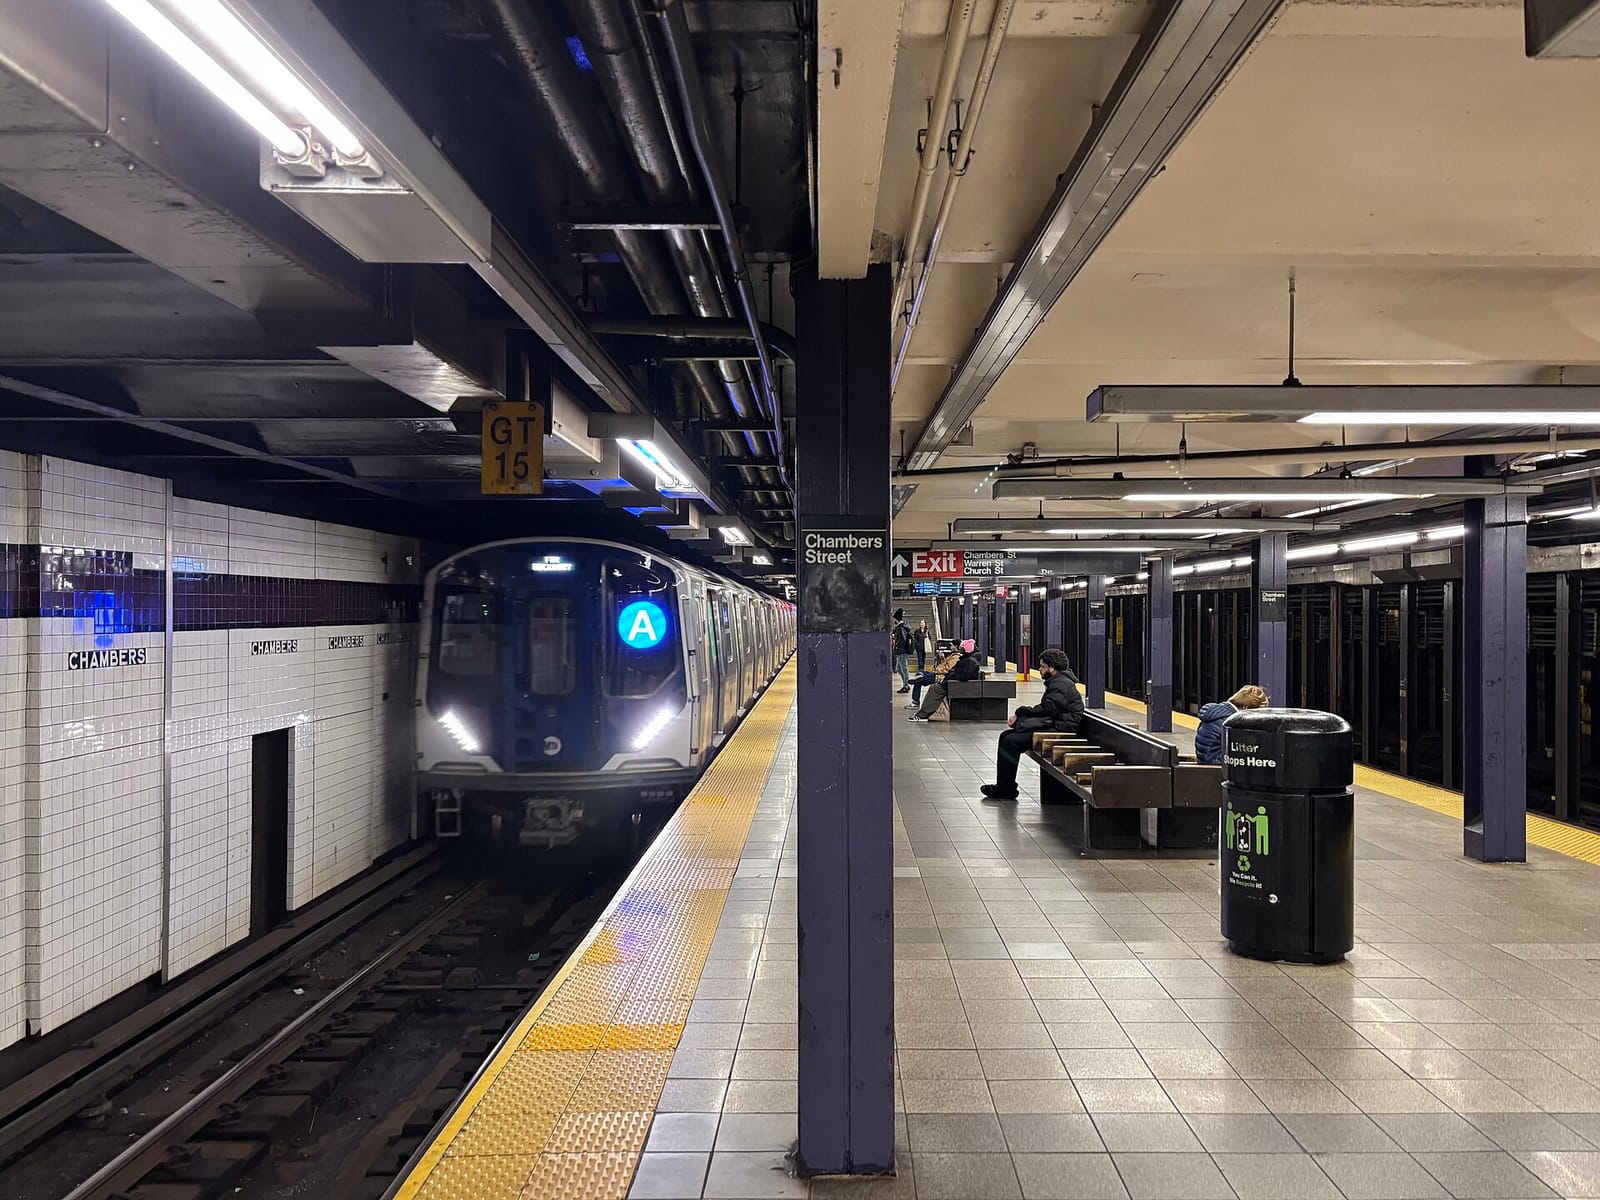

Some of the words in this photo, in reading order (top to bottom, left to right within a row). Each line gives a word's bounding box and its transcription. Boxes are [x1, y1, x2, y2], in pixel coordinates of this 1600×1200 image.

[491, 416, 535, 445] GT
[496, 451, 528, 479] 15
[805, 533, 883, 548] Chambers
[805, 549, 853, 563] Street
[912, 552, 957, 572] Exit
[963, 551, 1004, 559] Chambers
[1007, 551, 1017, 559] St
[964, 559, 992, 567] Warren
[994, 559, 1004, 567] St
[627, 609, 657, 640] A
[251, 640, 298, 655] CHAMBERS
[329, 635, 364, 649] CHAMBERS
[68, 647, 146, 670] CHAMBERS
[1231, 742, 1259, 753] Litter
[1223, 754, 1245, 767] Stops
[1246, 756, 1276, 767] Here
